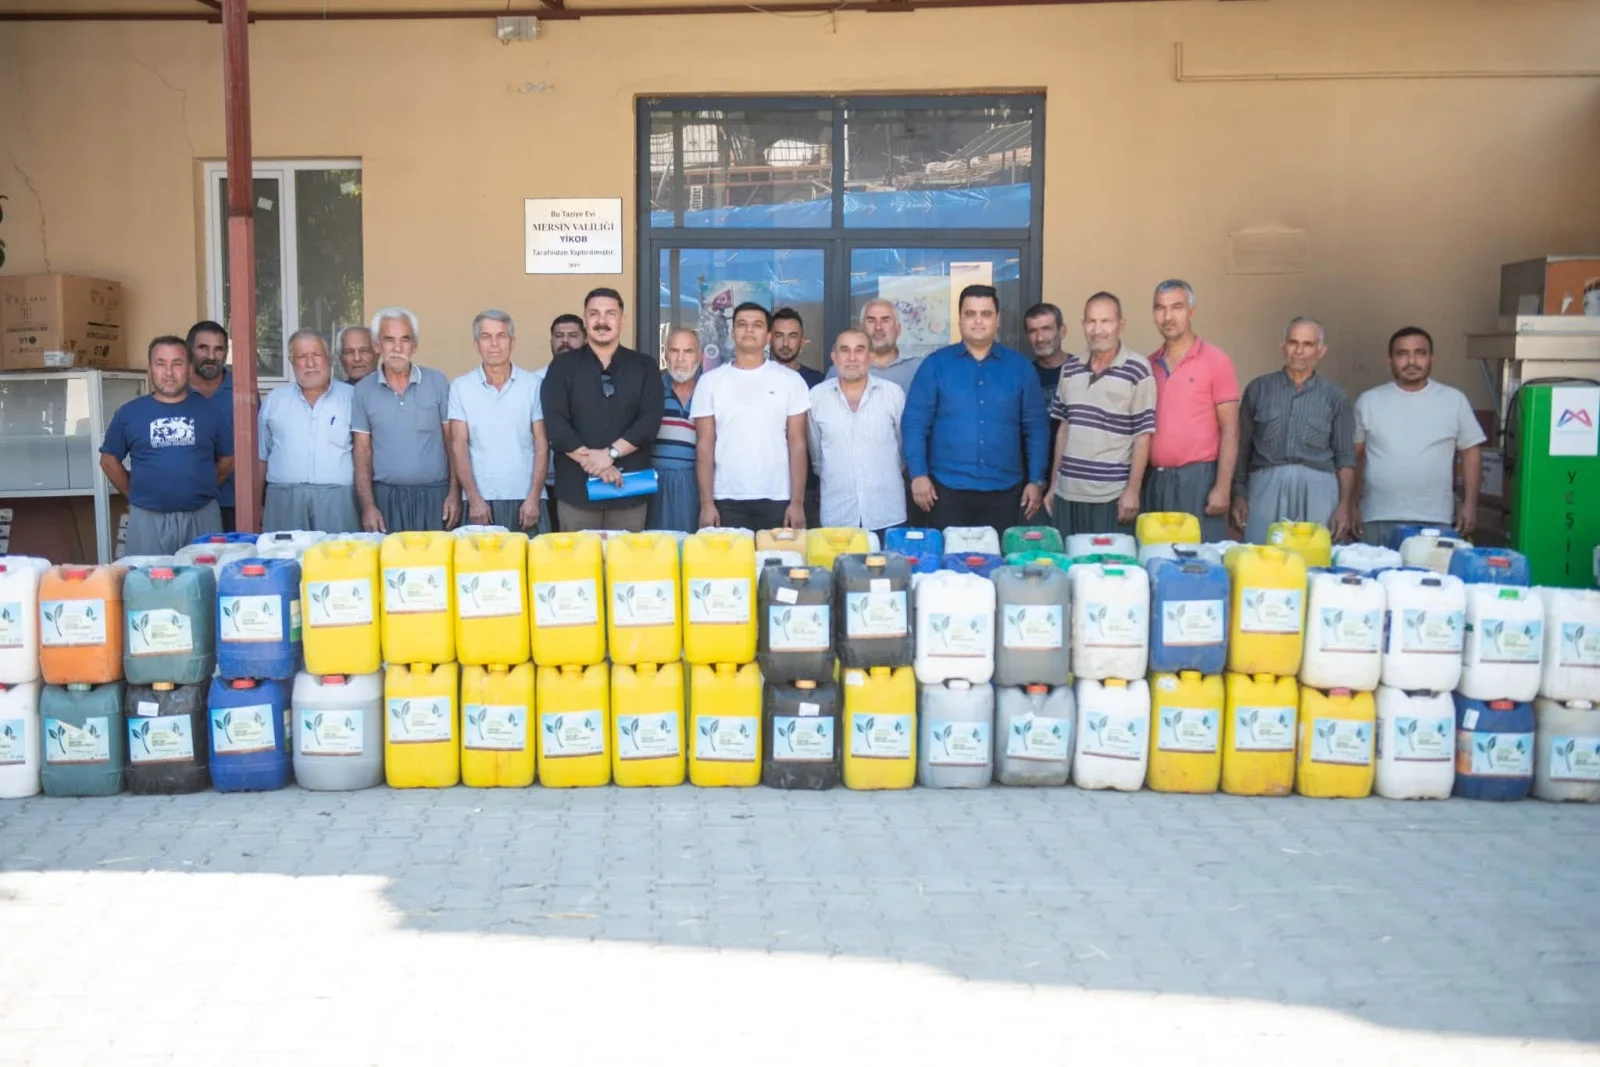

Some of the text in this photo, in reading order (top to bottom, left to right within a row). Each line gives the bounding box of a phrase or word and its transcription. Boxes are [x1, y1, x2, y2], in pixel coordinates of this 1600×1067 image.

[562, 210, 583, 219] Taziye
[532, 220, 614, 231] MERSİN VALİLİĞİ
[560, 234, 588, 243] YİKOB
